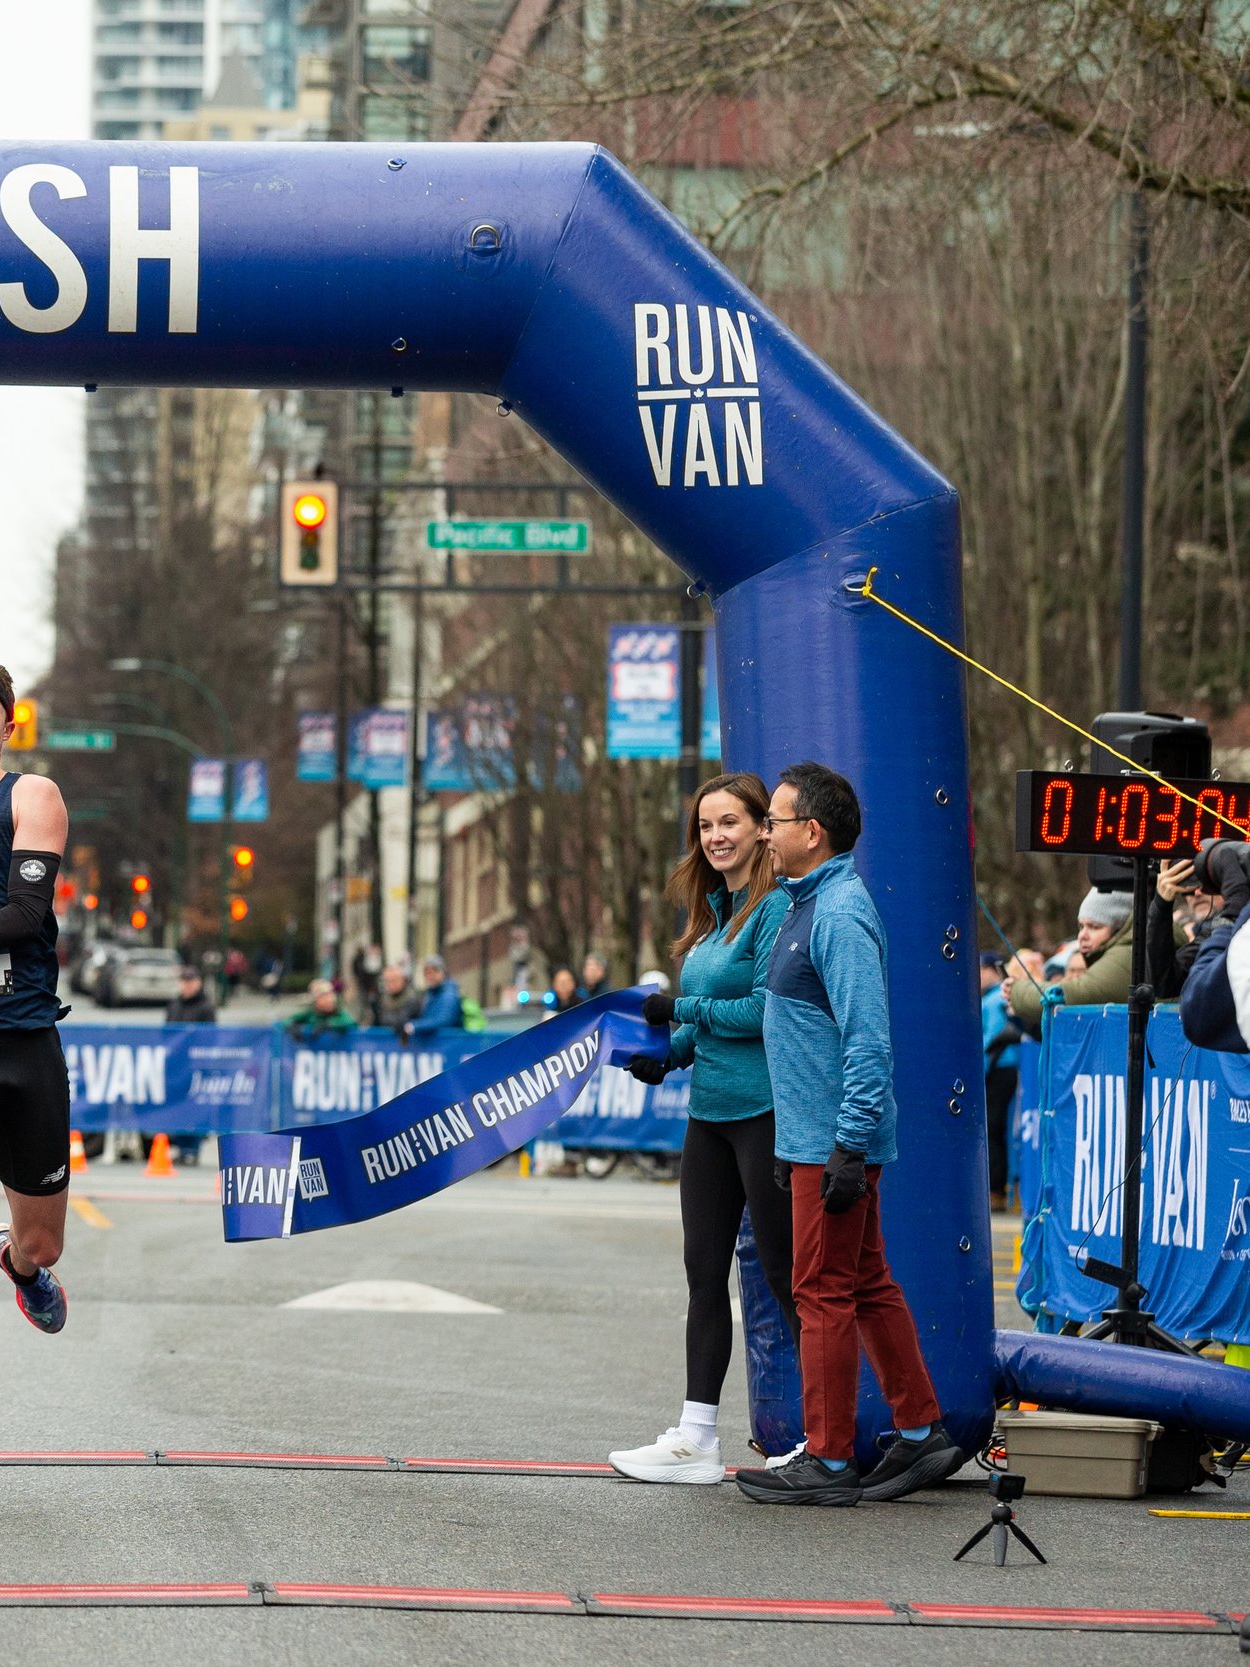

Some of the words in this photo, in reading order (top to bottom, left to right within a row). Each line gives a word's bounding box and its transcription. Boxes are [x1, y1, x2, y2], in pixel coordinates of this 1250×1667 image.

[635, 304, 758, 385] RUN
[638, 402, 763, 486] VAN
[80, 1044, 167, 1104] VAN
[293, 1050, 362, 1112] RUN
[361, 1131, 412, 1184] RUN
[419, 1103, 474, 1157] VAN
[472, 1030, 600, 1128] CHAMPION
[236, 1166, 287, 1205] VAN
[299, 1162, 321, 1178] RUN
[303, 1177, 325, 1194] VAN
[1151, 1076, 1209, 1251] VAN
